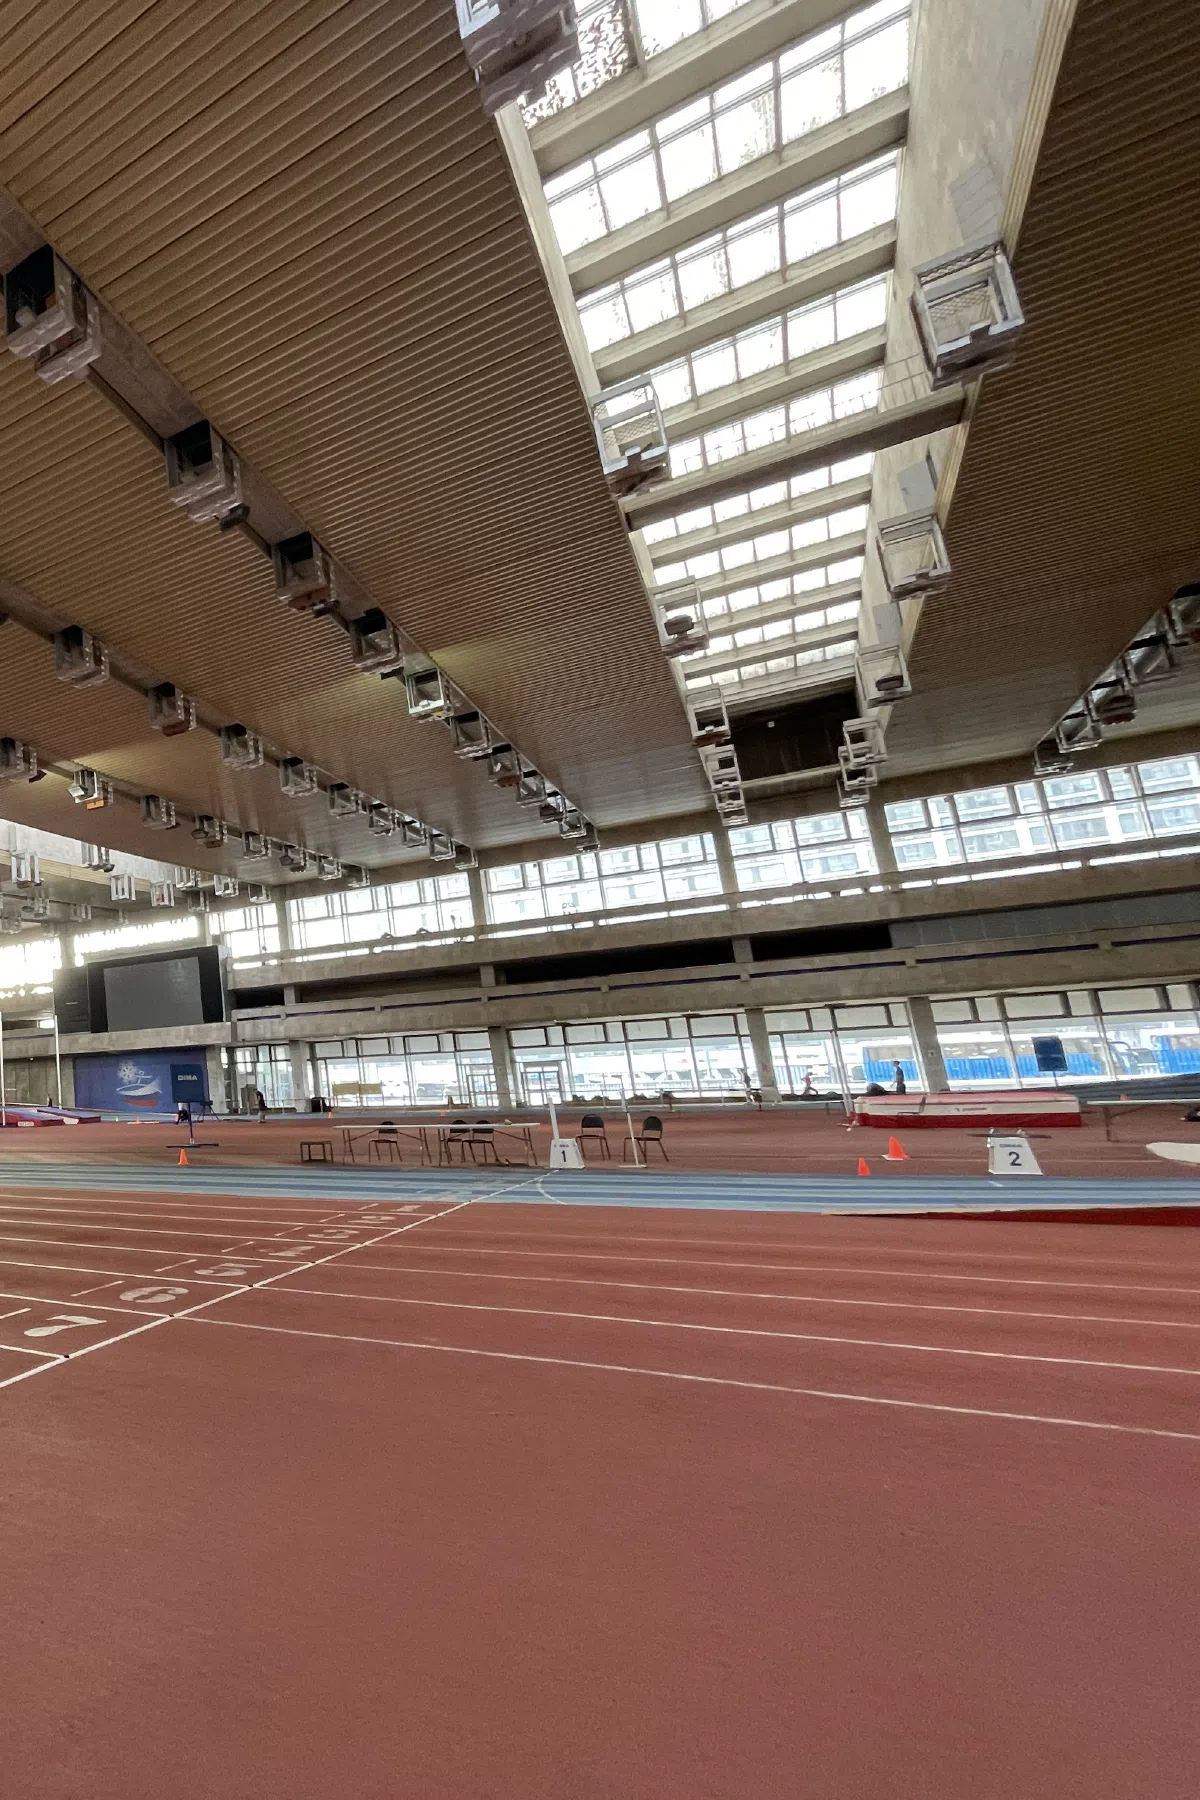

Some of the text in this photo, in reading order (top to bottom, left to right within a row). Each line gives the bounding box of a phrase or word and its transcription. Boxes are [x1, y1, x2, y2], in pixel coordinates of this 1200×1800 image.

[561, 1150, 567, 1163] 1
[1008, 1151, 1023, 1167] 2
[348, 1215, 397, 1224] 2
[308, 1229, 361, 1239] 3
[194, 1262, 263, 1277] 5
[118, 1285, 190, 1304] 6
[23, 1313, 108, 1338] 7
